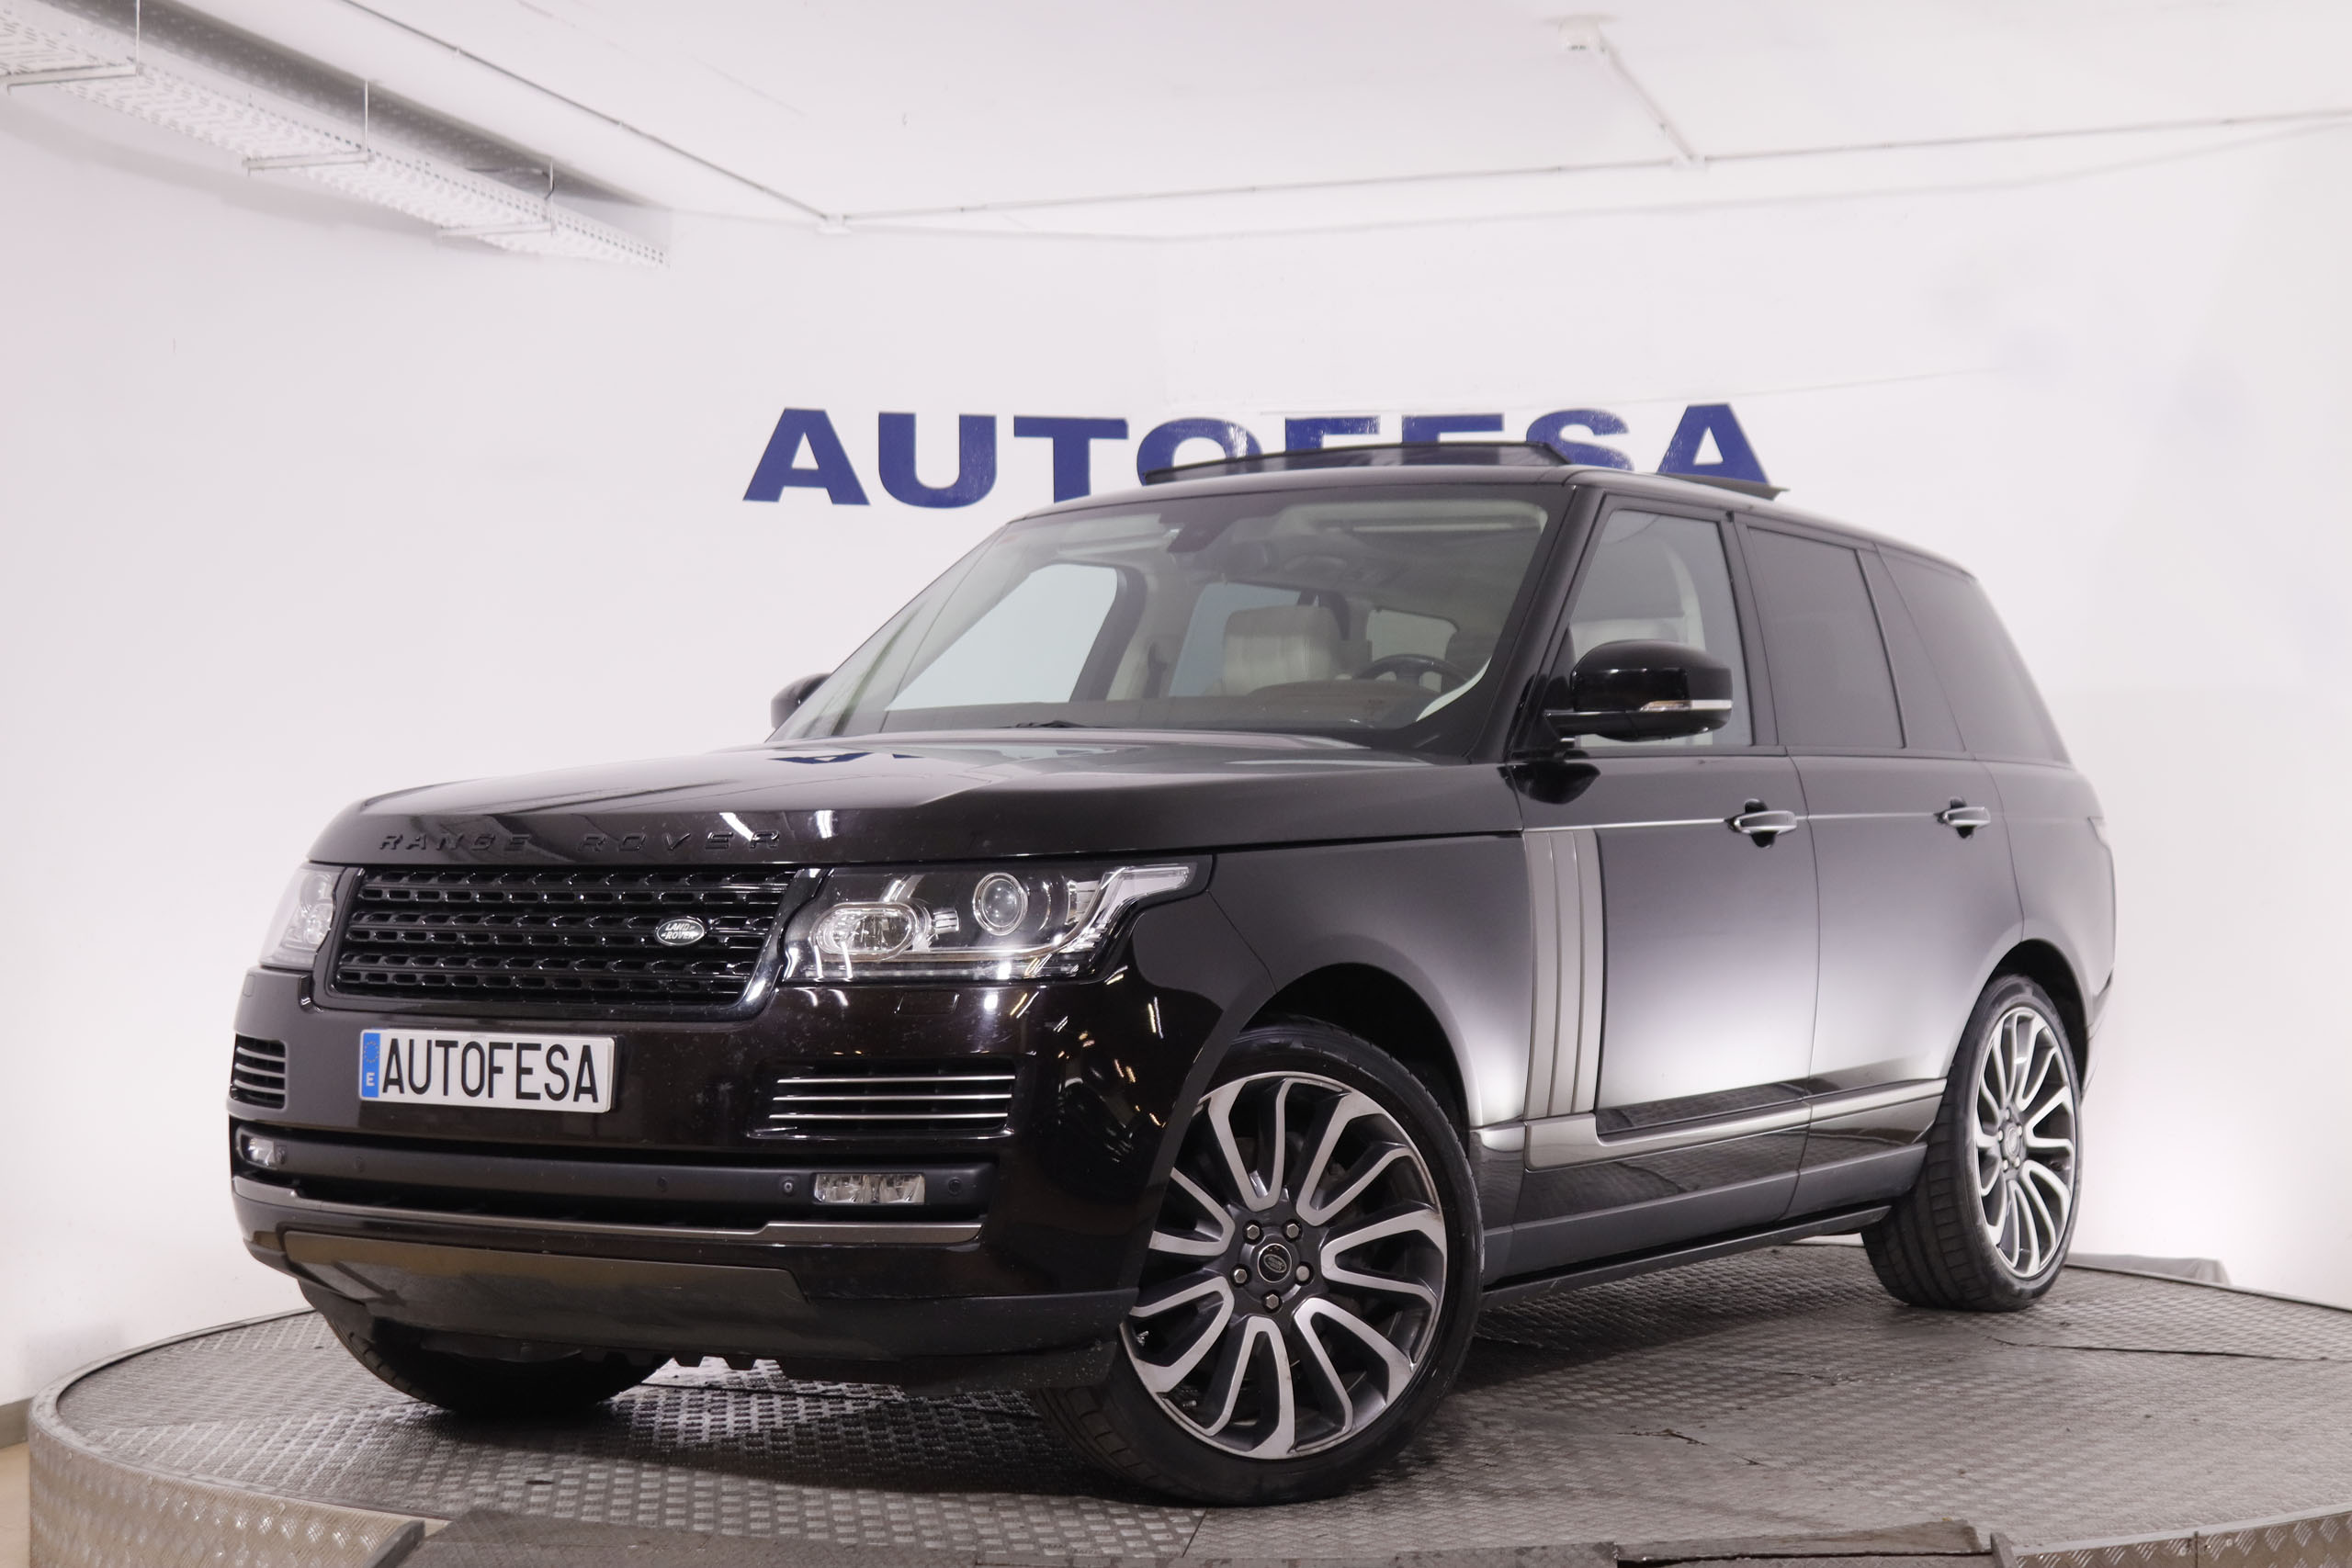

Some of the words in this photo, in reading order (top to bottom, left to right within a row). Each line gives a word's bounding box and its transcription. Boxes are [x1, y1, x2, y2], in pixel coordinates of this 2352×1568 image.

[379, 833, 530, 852] RANGE
[577, 830, 781, 852] ROVER
[366, 1072, 375, 1087] E
[382, 1037, 599, 1102] AUTOFESA
